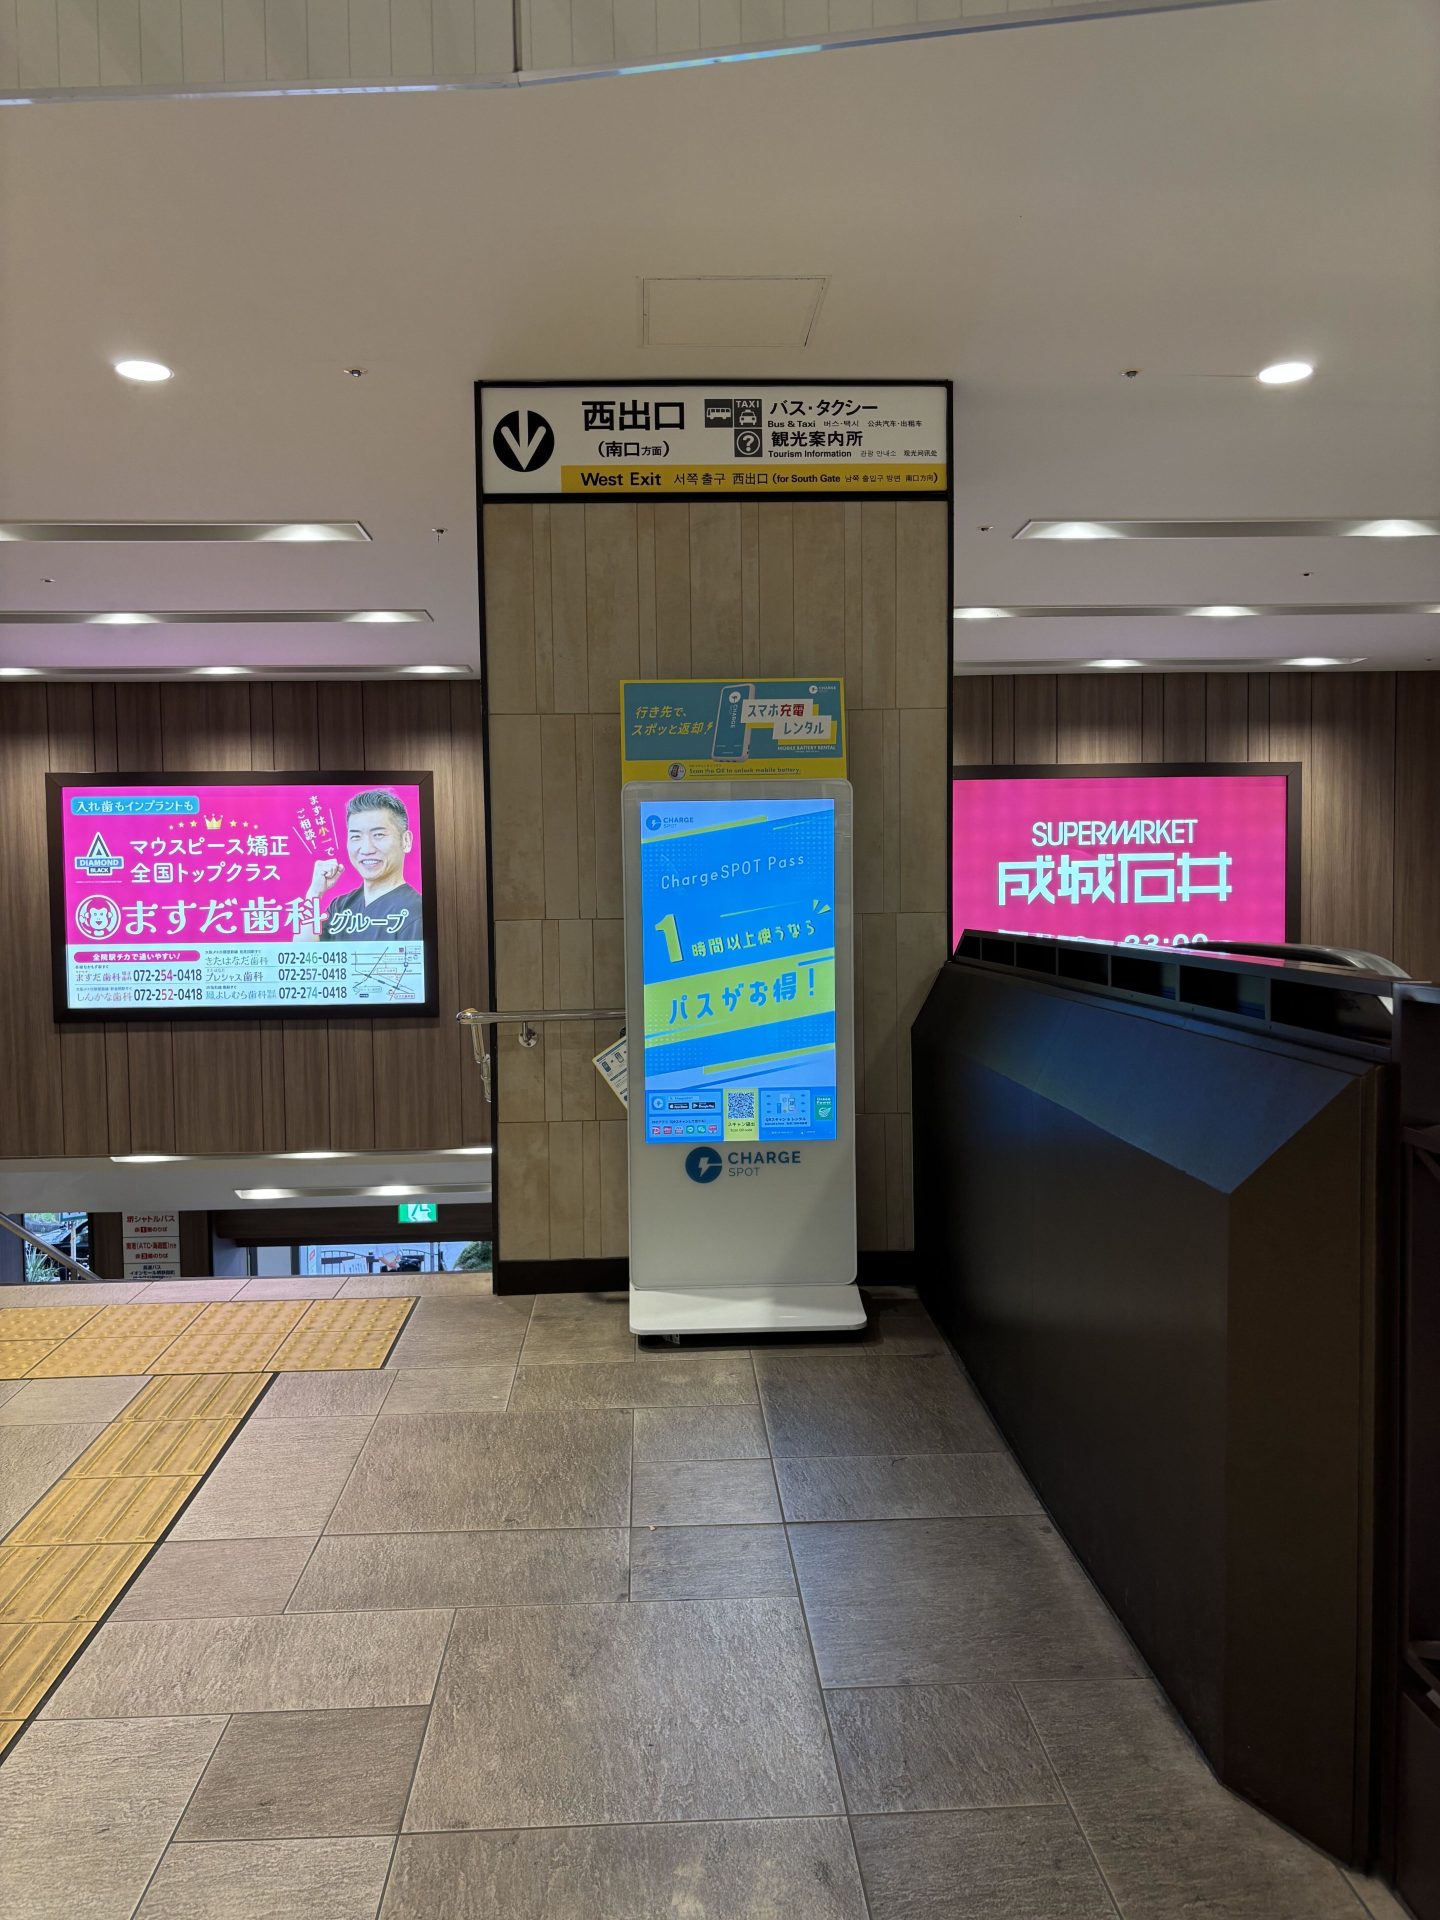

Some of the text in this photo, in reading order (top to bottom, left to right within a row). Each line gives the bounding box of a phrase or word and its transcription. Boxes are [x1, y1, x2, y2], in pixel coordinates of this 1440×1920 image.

[736, 400, 760, 408] TAXI
[770, 399, 878, 416] バス・タクシー
[582, 400, 684, 431] 西出口
[771, 431, 863, 447] 観光案内所
[598, 440, 670, 457] (南口方面)
[768, 450, 852, 458] Tourism Information
[580, 472, 662, 487] West Exit
[732, 472, 768, 485] 西出口
[791, 474, 818, 484] South
[820, 474, 841, 483] Gate
[748, 703, 805, 717] スマホ充電
[783, 721, 825, 735] レンタル
[76, 800, 194, 813] 入れ歯もインプラントも
[662, 816, 694, 824] CHARGE
[1031, 818, 1198, 847] SUPERMARKET
[129, 834, 291, 857] マウスピース矯正
[79, 858, 119, 867] DIAMOND
[130, 861, 281, 883] 全国トップクラス
[661, 855, 804, 889] ChargeSPOT Pass
[998, 851, 1233, 905] 成城石井
[278, 951, 348, 964] 072-246-0418
[133, 969, 203, 982] 072-254-0418
[278, 968, 347, 981] 072-257-0418
[133, 988, 203, 1001] 072-252-0418
[278, 986, 348, 999] 072-274-0418
[727, 1150, 801, 1165] CHARGE
[728, 1166, 760, 1177] SPOT
